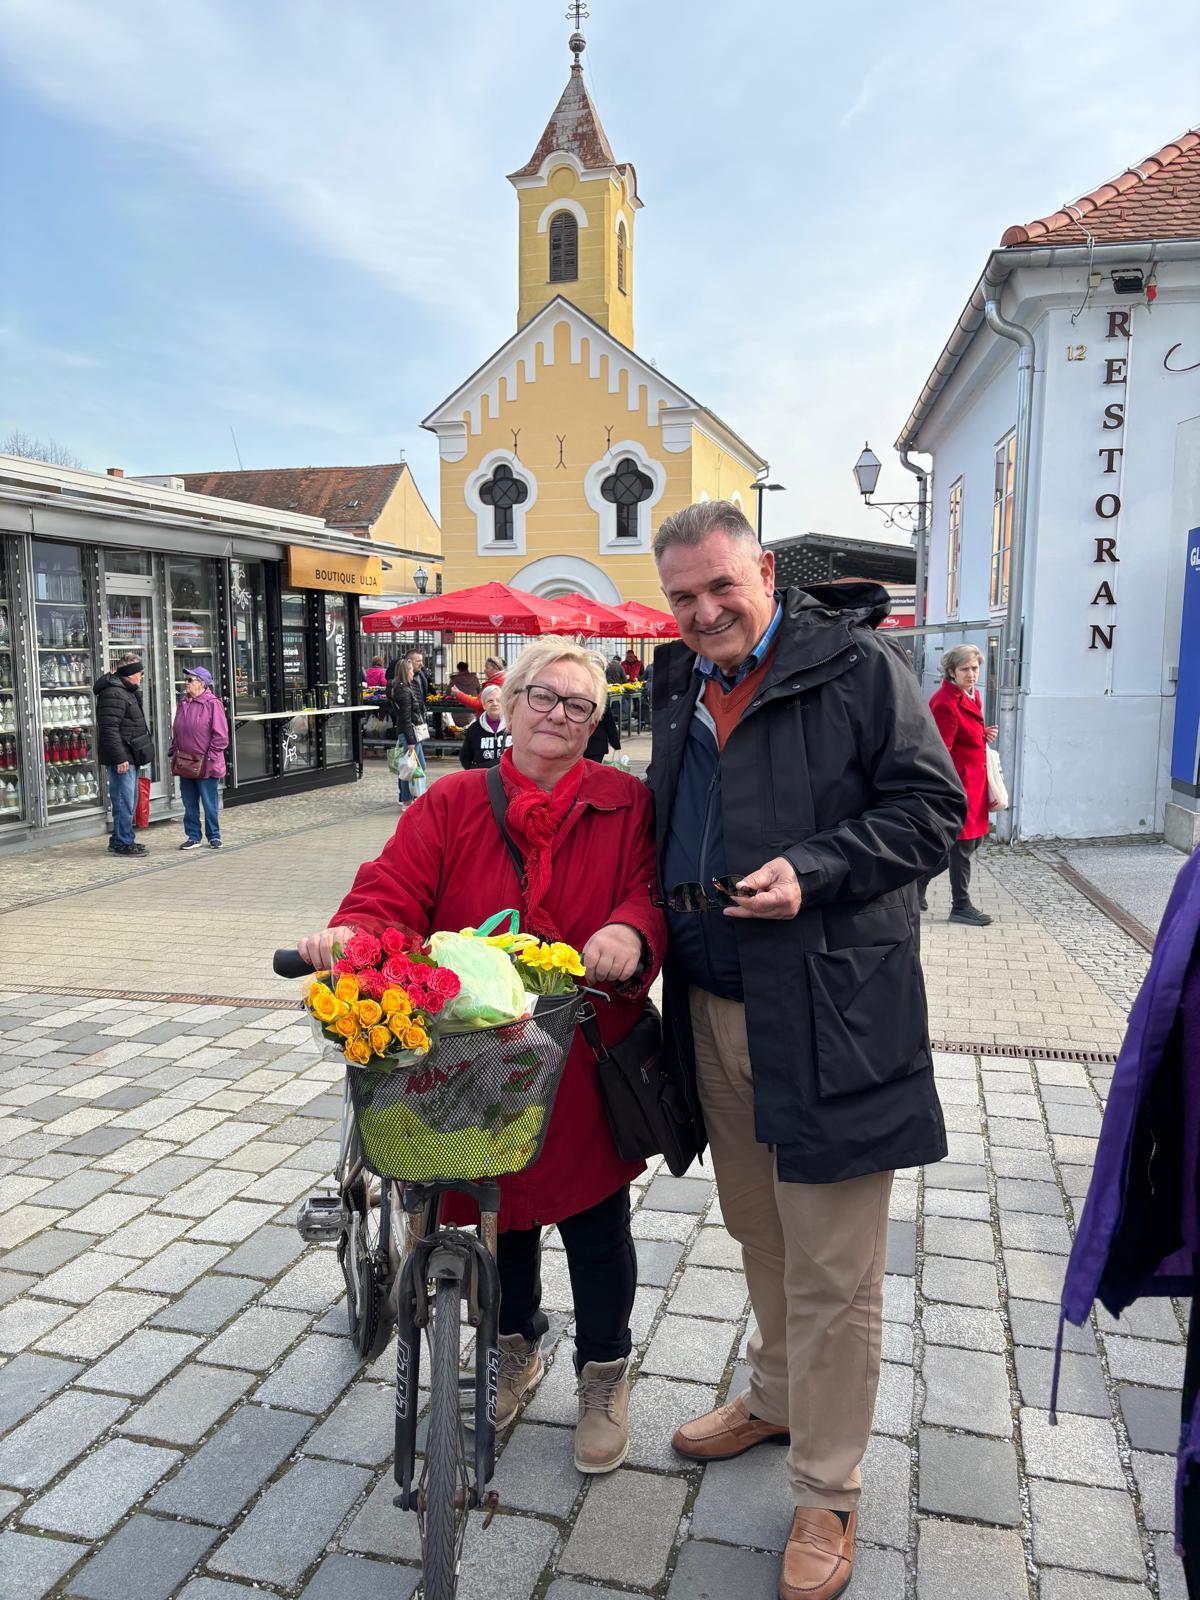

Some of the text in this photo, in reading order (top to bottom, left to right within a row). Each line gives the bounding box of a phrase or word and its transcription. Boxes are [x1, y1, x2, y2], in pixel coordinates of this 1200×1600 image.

[1067, 344, 1087, 361] 12
[1088, 311, 1133, 650] RESTORAN
[315, 569, 378, 587] BOUTIQUE ULJA
